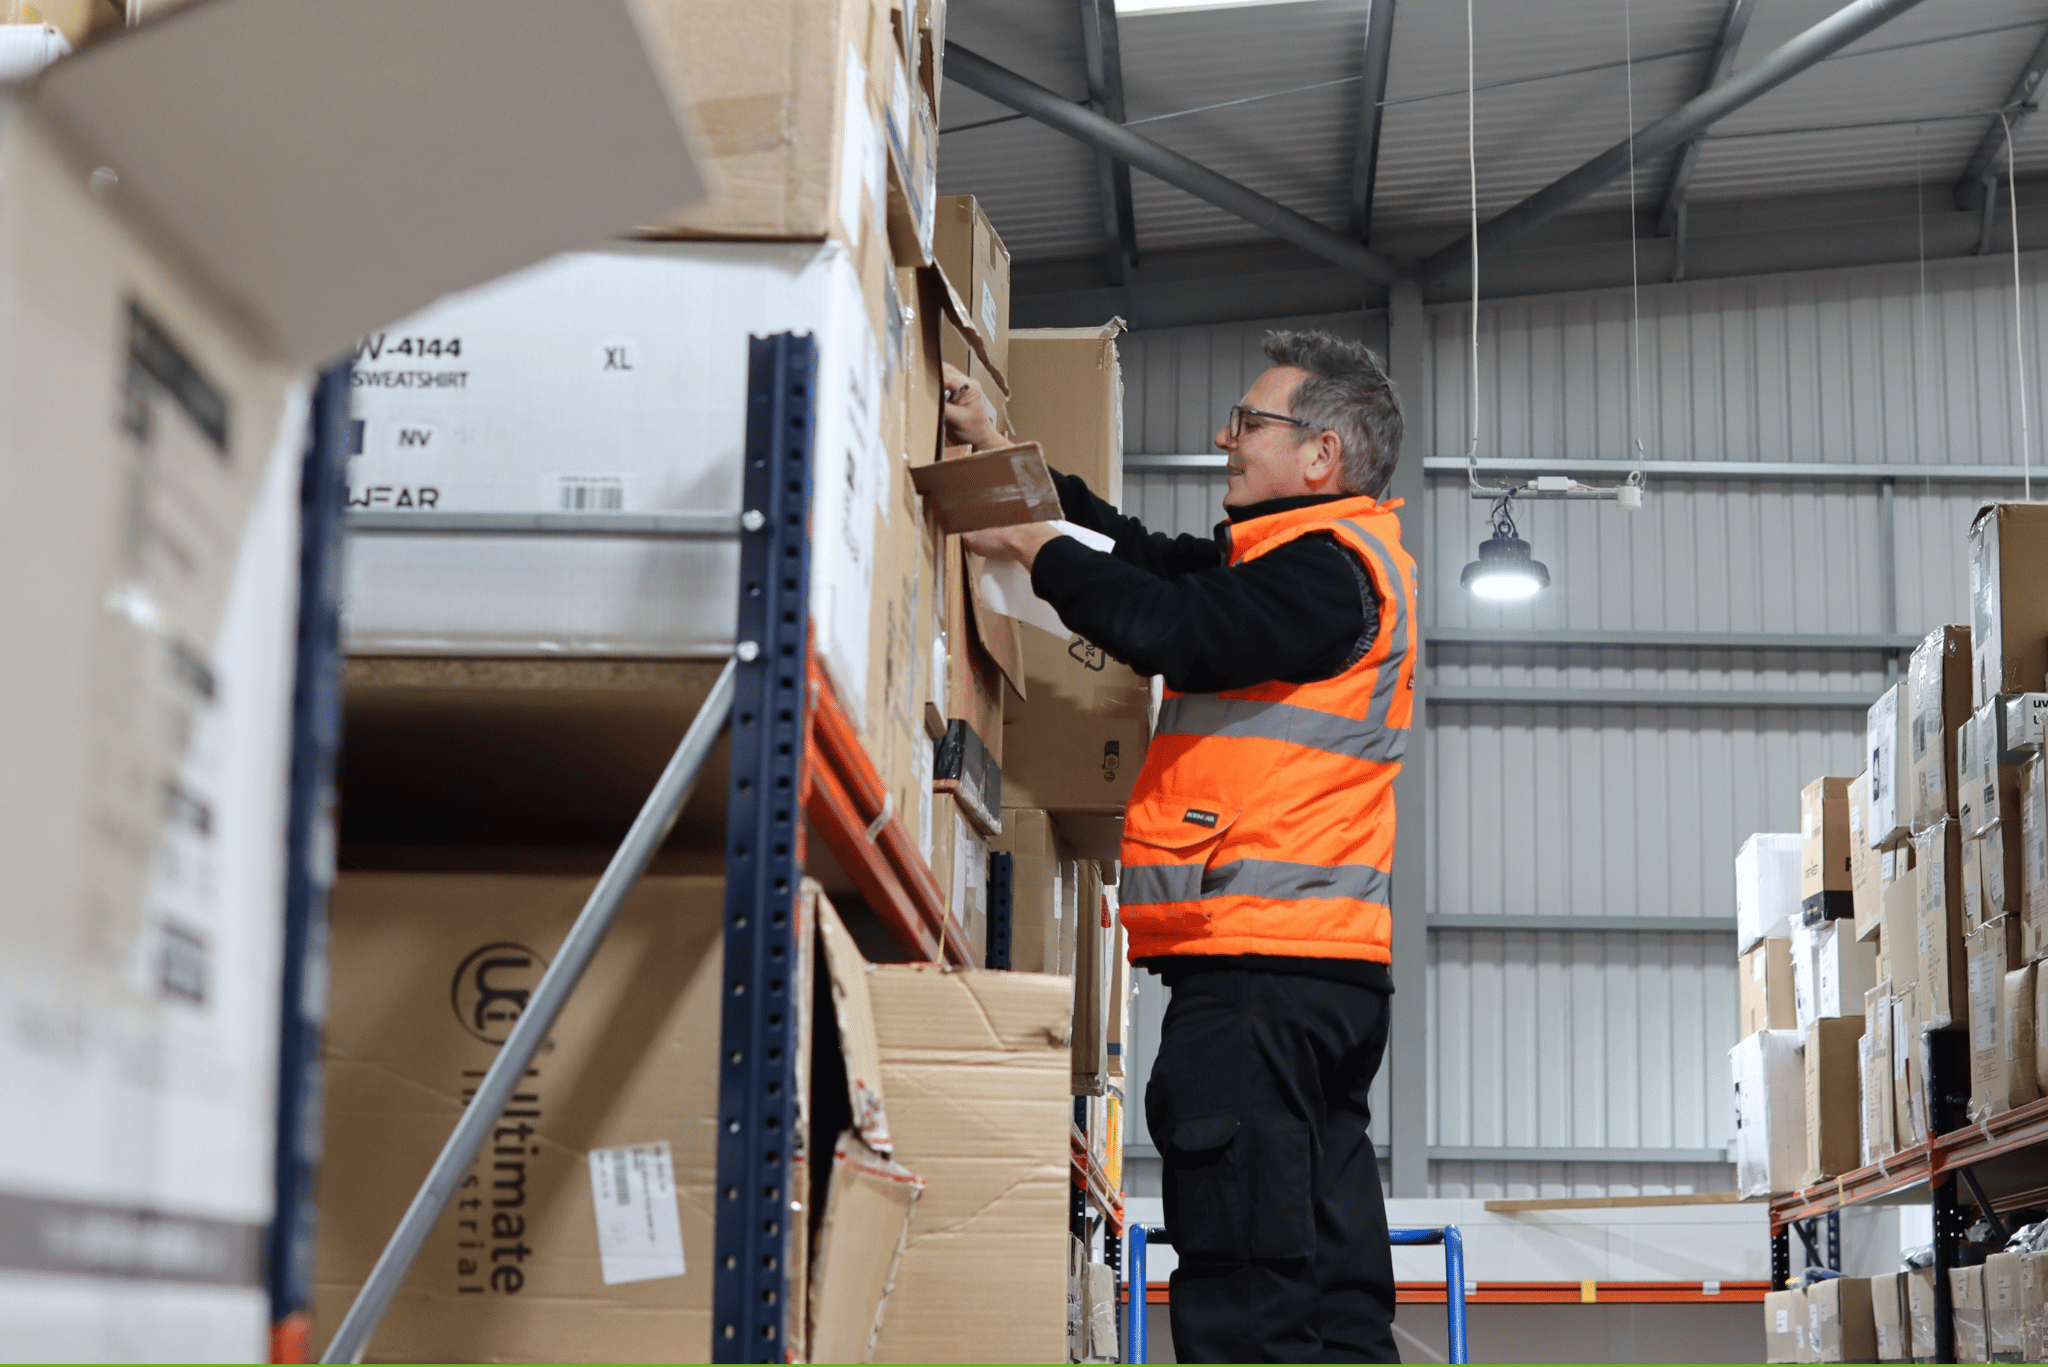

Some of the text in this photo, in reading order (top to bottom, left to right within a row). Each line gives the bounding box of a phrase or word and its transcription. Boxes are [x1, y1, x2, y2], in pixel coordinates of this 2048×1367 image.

[603, 347, 632, 371] XL
[352, 370, 468, 388] SWEATSHIRT
[398, 429, 432, 447] NV
